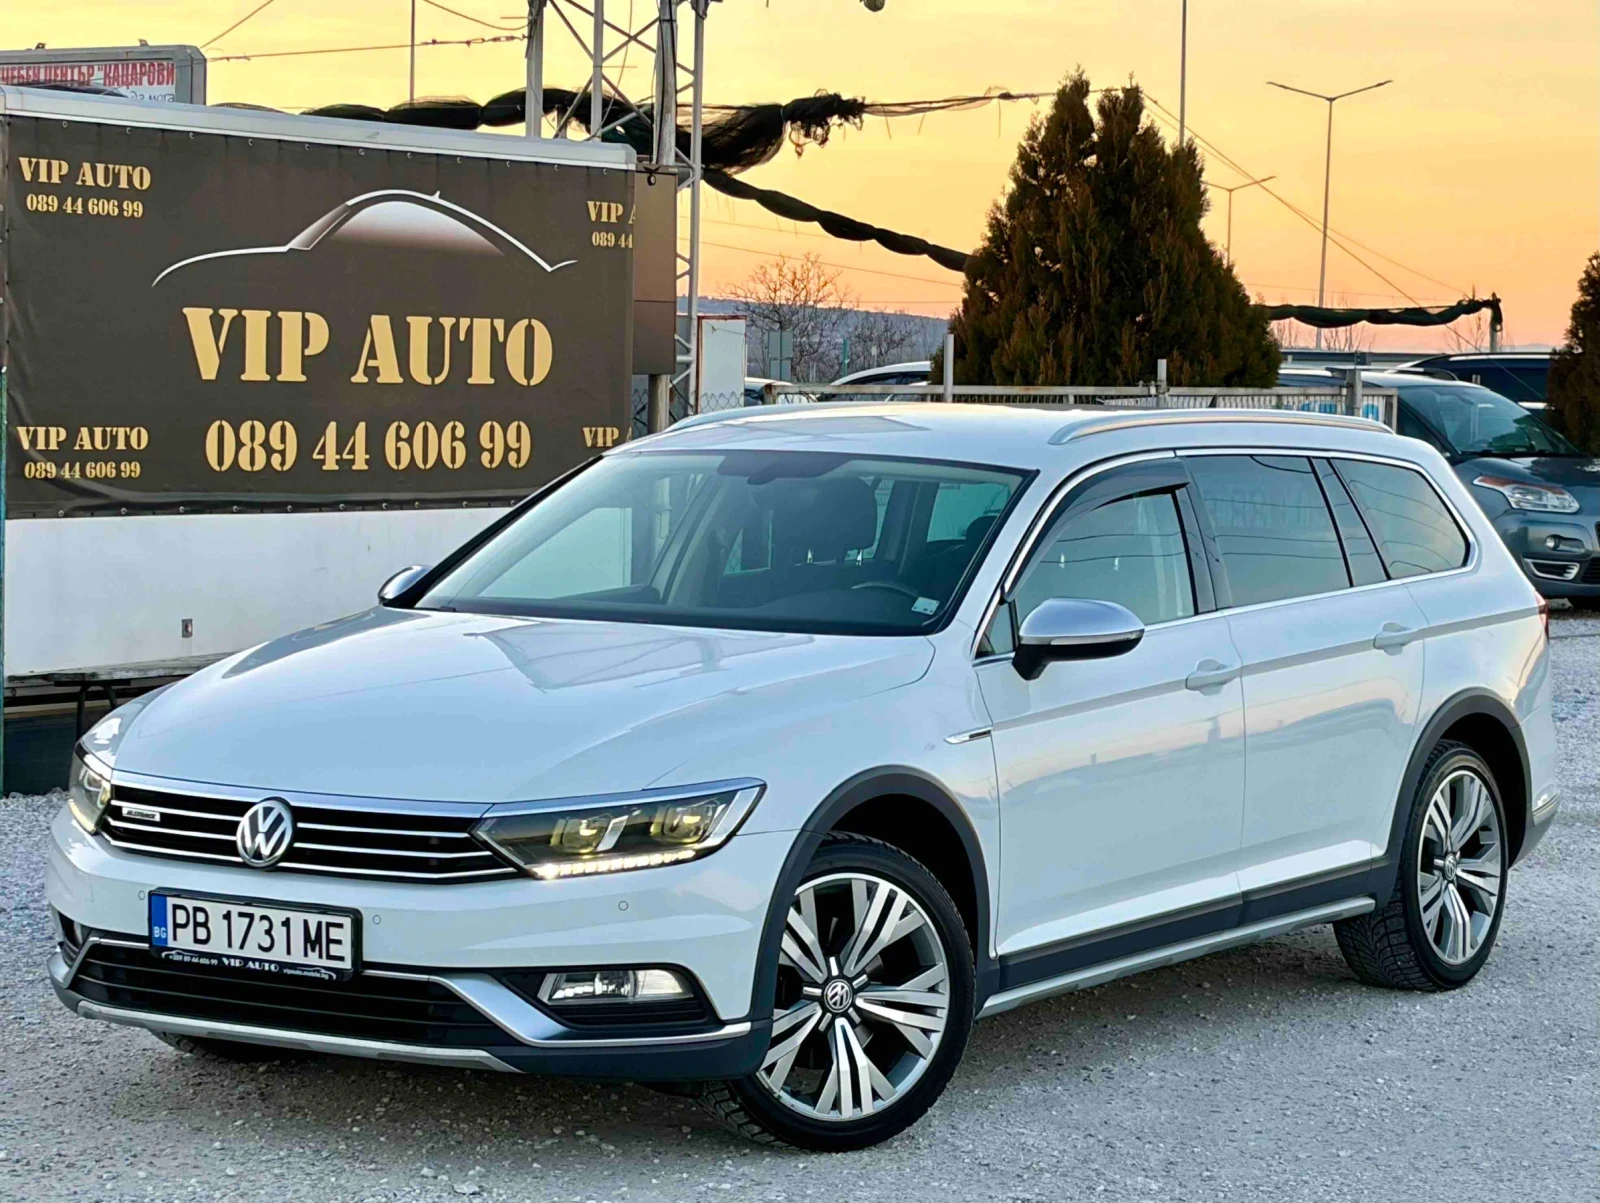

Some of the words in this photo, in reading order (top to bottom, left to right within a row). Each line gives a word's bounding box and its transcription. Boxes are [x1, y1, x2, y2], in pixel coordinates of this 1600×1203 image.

[18, 157, 69, 184] VIP
[75, 162, 151, 190] AUTO
[26, 193, 59, 213] 089
[62, 196, 84, 215] 44
[88, 198, 119, 217] 606
[122, 200, 144, 218] 99
[586, 200, 624, 223] VIP
[591, 231, 616, 248] 089
[617, 233, 633, 249] 44
[182, 307, 330, 382] VIP
[350, 314, 553, 386] AUTO
[16, 426, 67, 450] VIP
[73, 426, 149, 450] AUTO
[205, 420, 298, 471] 089
[312, 421, 370, 470] 44
[384, 420, 467, 470] 606
[479, 420, 532, 469] 99
[582, 426, 620, 447] VIP
[24, 461, 57, 479] 089
[60, 462, 81, 479] 44
[85, 461, 117, 479] 606
[120, 461, 141, 478] 99
[153, 926, 168, 939] BG
[171, 903, 212, 946] PB
[222, 910, 292, 956] 1731
[302, 918, 346, 962] ME
[221, 957, 244, 968] VIP
[245, 960, 280, 972] AUTO
